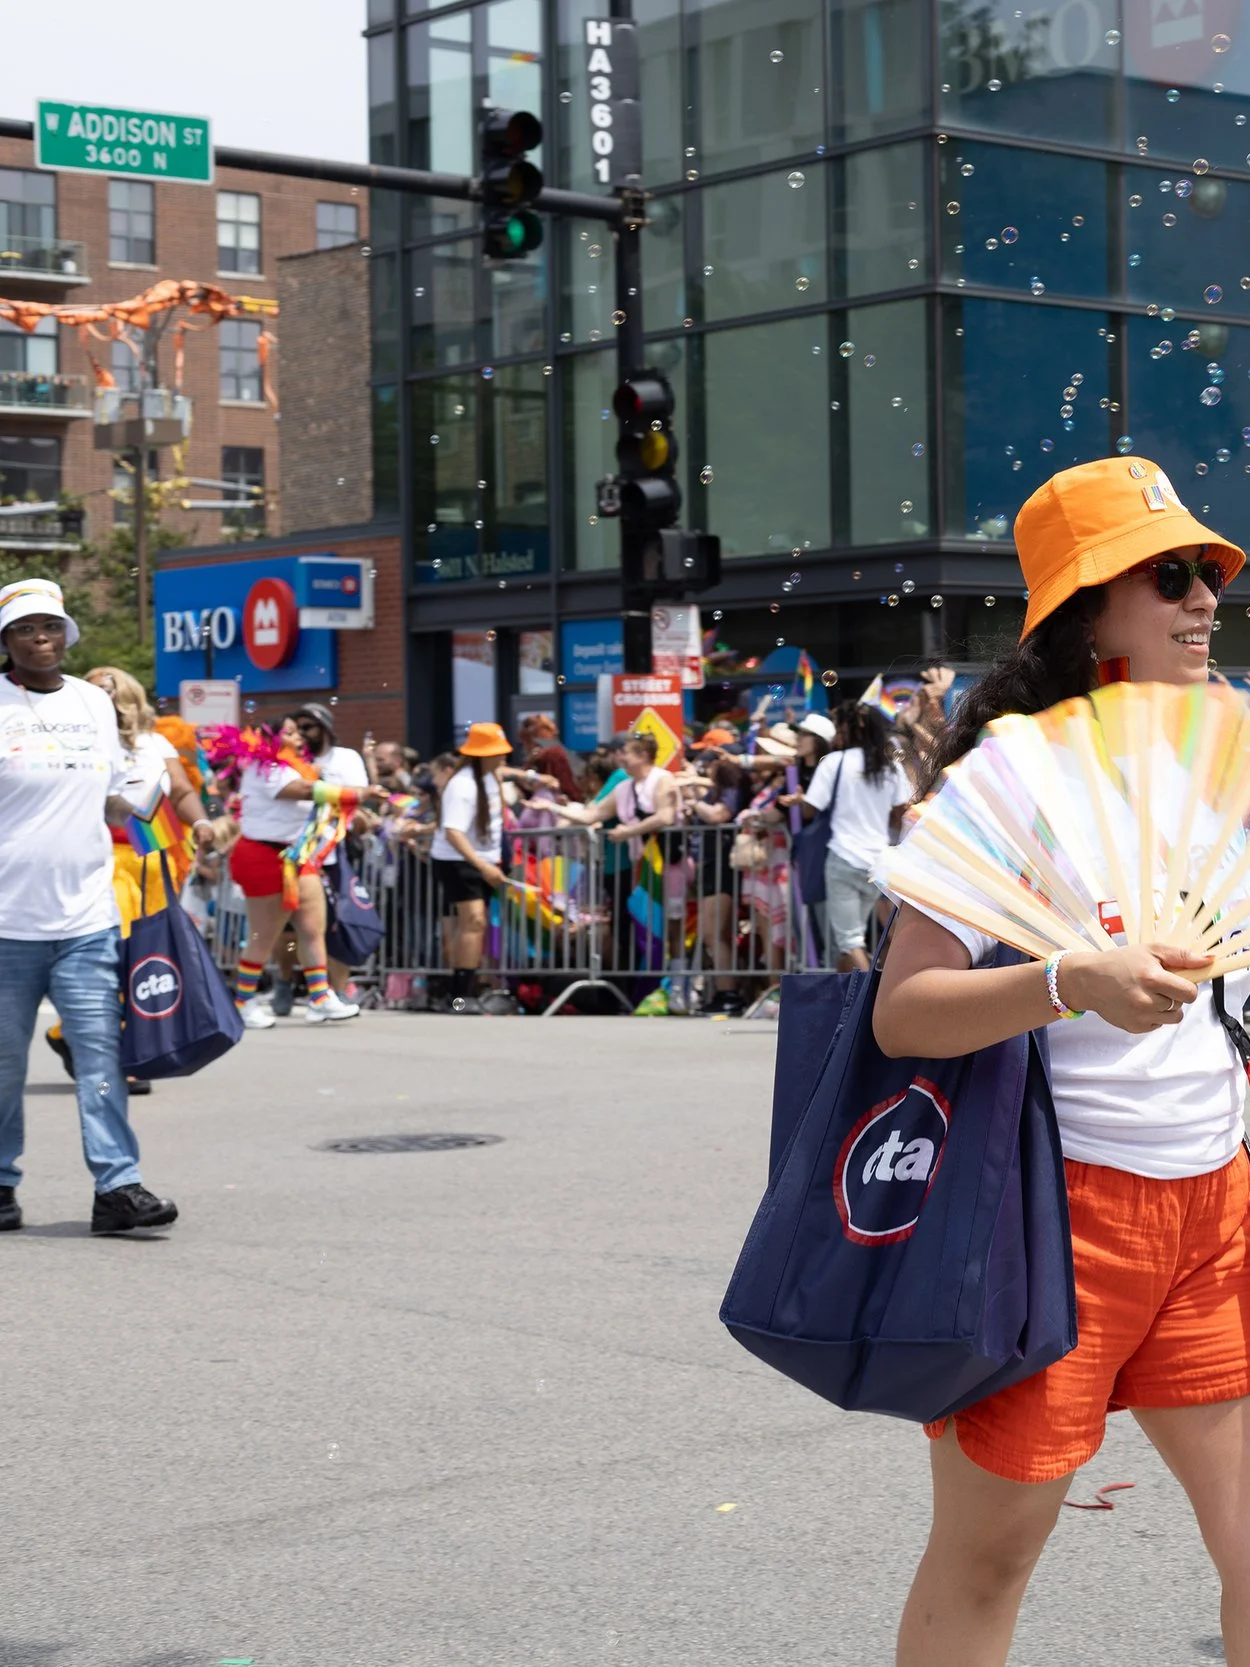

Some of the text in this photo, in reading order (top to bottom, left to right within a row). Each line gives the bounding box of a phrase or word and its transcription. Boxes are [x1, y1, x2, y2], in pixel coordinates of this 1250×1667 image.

[586, 20, 613, 183] HA3601
[44, 111, 204, 148] W ADDISON ST
[85, 144, 168, 171] 3600 N
[163, 606, 237, 653] BMO
[614, 692, 682, 707] CROSSING
[621, 679, 673, 693] STREET
[135, 973, 175, 1001] cta
